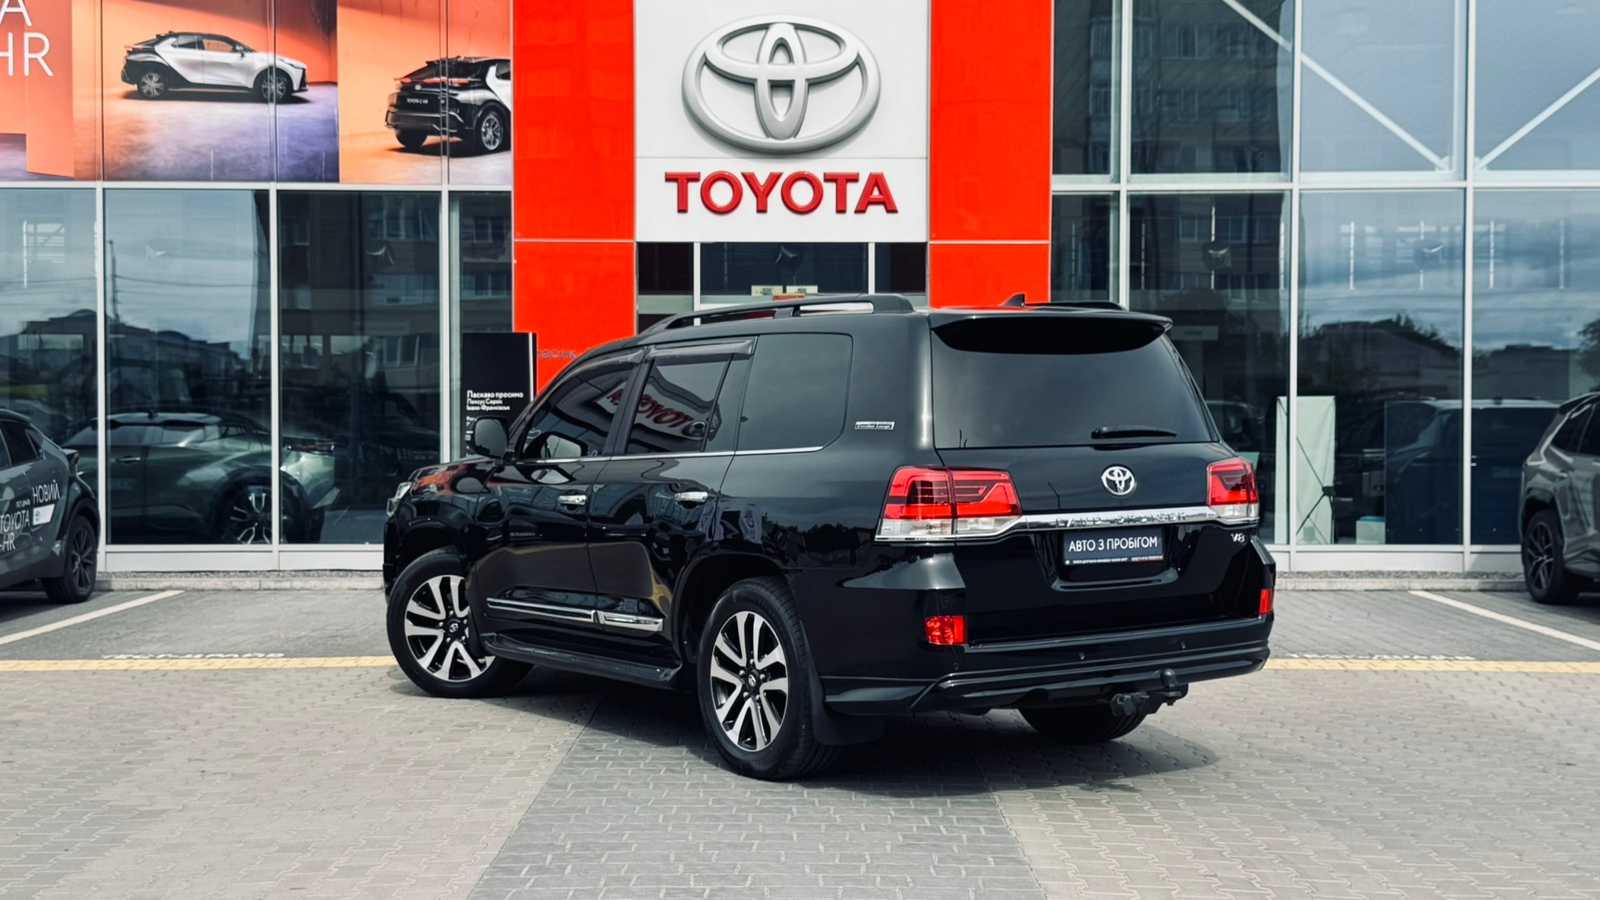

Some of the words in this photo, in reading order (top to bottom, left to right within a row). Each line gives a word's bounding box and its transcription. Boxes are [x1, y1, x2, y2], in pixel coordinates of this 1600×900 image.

[664, 170, 899, 214] TOYOTA
[32, 479, 60, 504] НОВИЙ
[1068, 539, 1096, 552] АВТО
[1106, 536, 1158, 550] ПРОБІГОМ
[1231, 533, 1245, 543] V8
